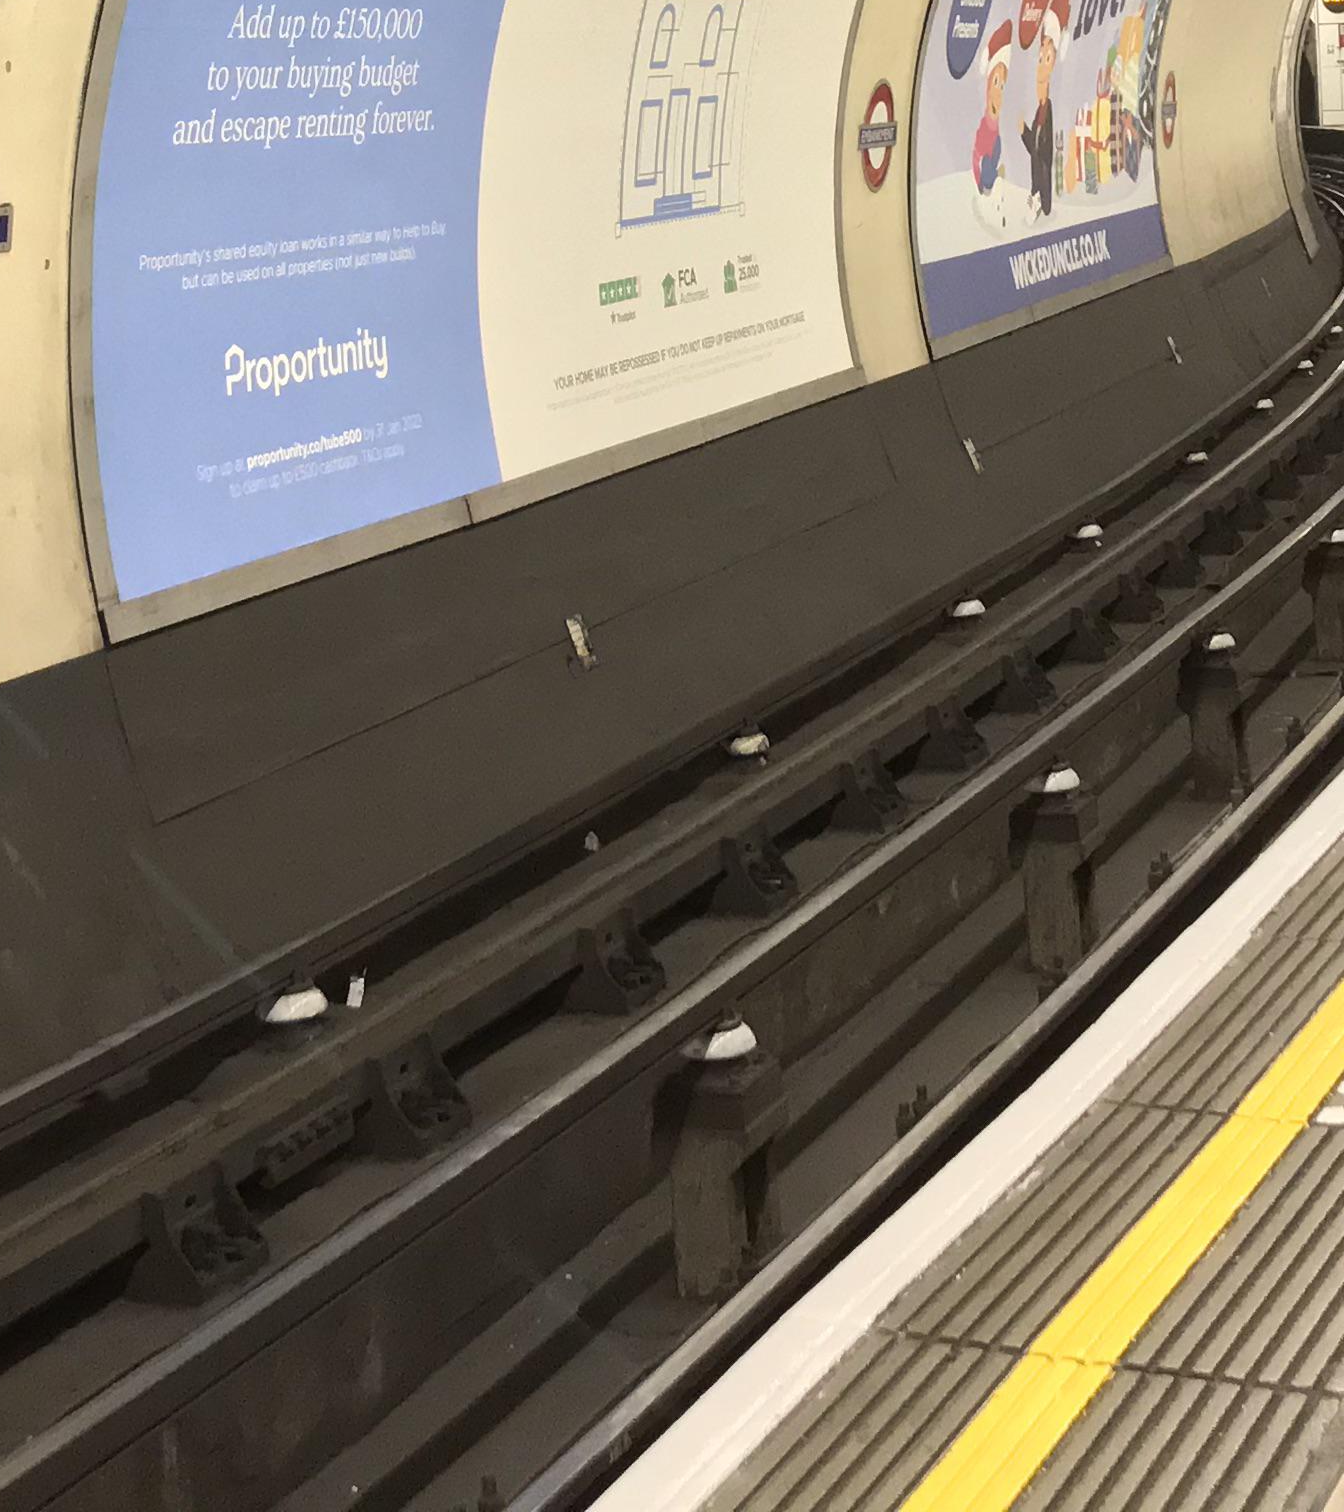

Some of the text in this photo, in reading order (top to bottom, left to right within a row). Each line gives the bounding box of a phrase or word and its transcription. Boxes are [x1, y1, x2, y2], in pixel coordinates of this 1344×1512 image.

[227, 3, 424, 48] Add up to £150,000
[207, 54, 420, 100] to your buying budget
[172, 101, 435, 149] and escape renting forever.
[138, 248, 212, 272] Proportunity's
[678, 268, 697, 287] FCA
[1009, 229, 1111, 290] WICKEDUNCLE.CO.UK
[224, 327, 389, 397] Proportunity
[553, 374, 574, 391] YOUR
[574, 369, 595, 386] HOME
[595, 364, 609, 380] MAY
[609, 362, 619, 376] BE
[247, 427, 362, 472] proportunity.co/tube500
